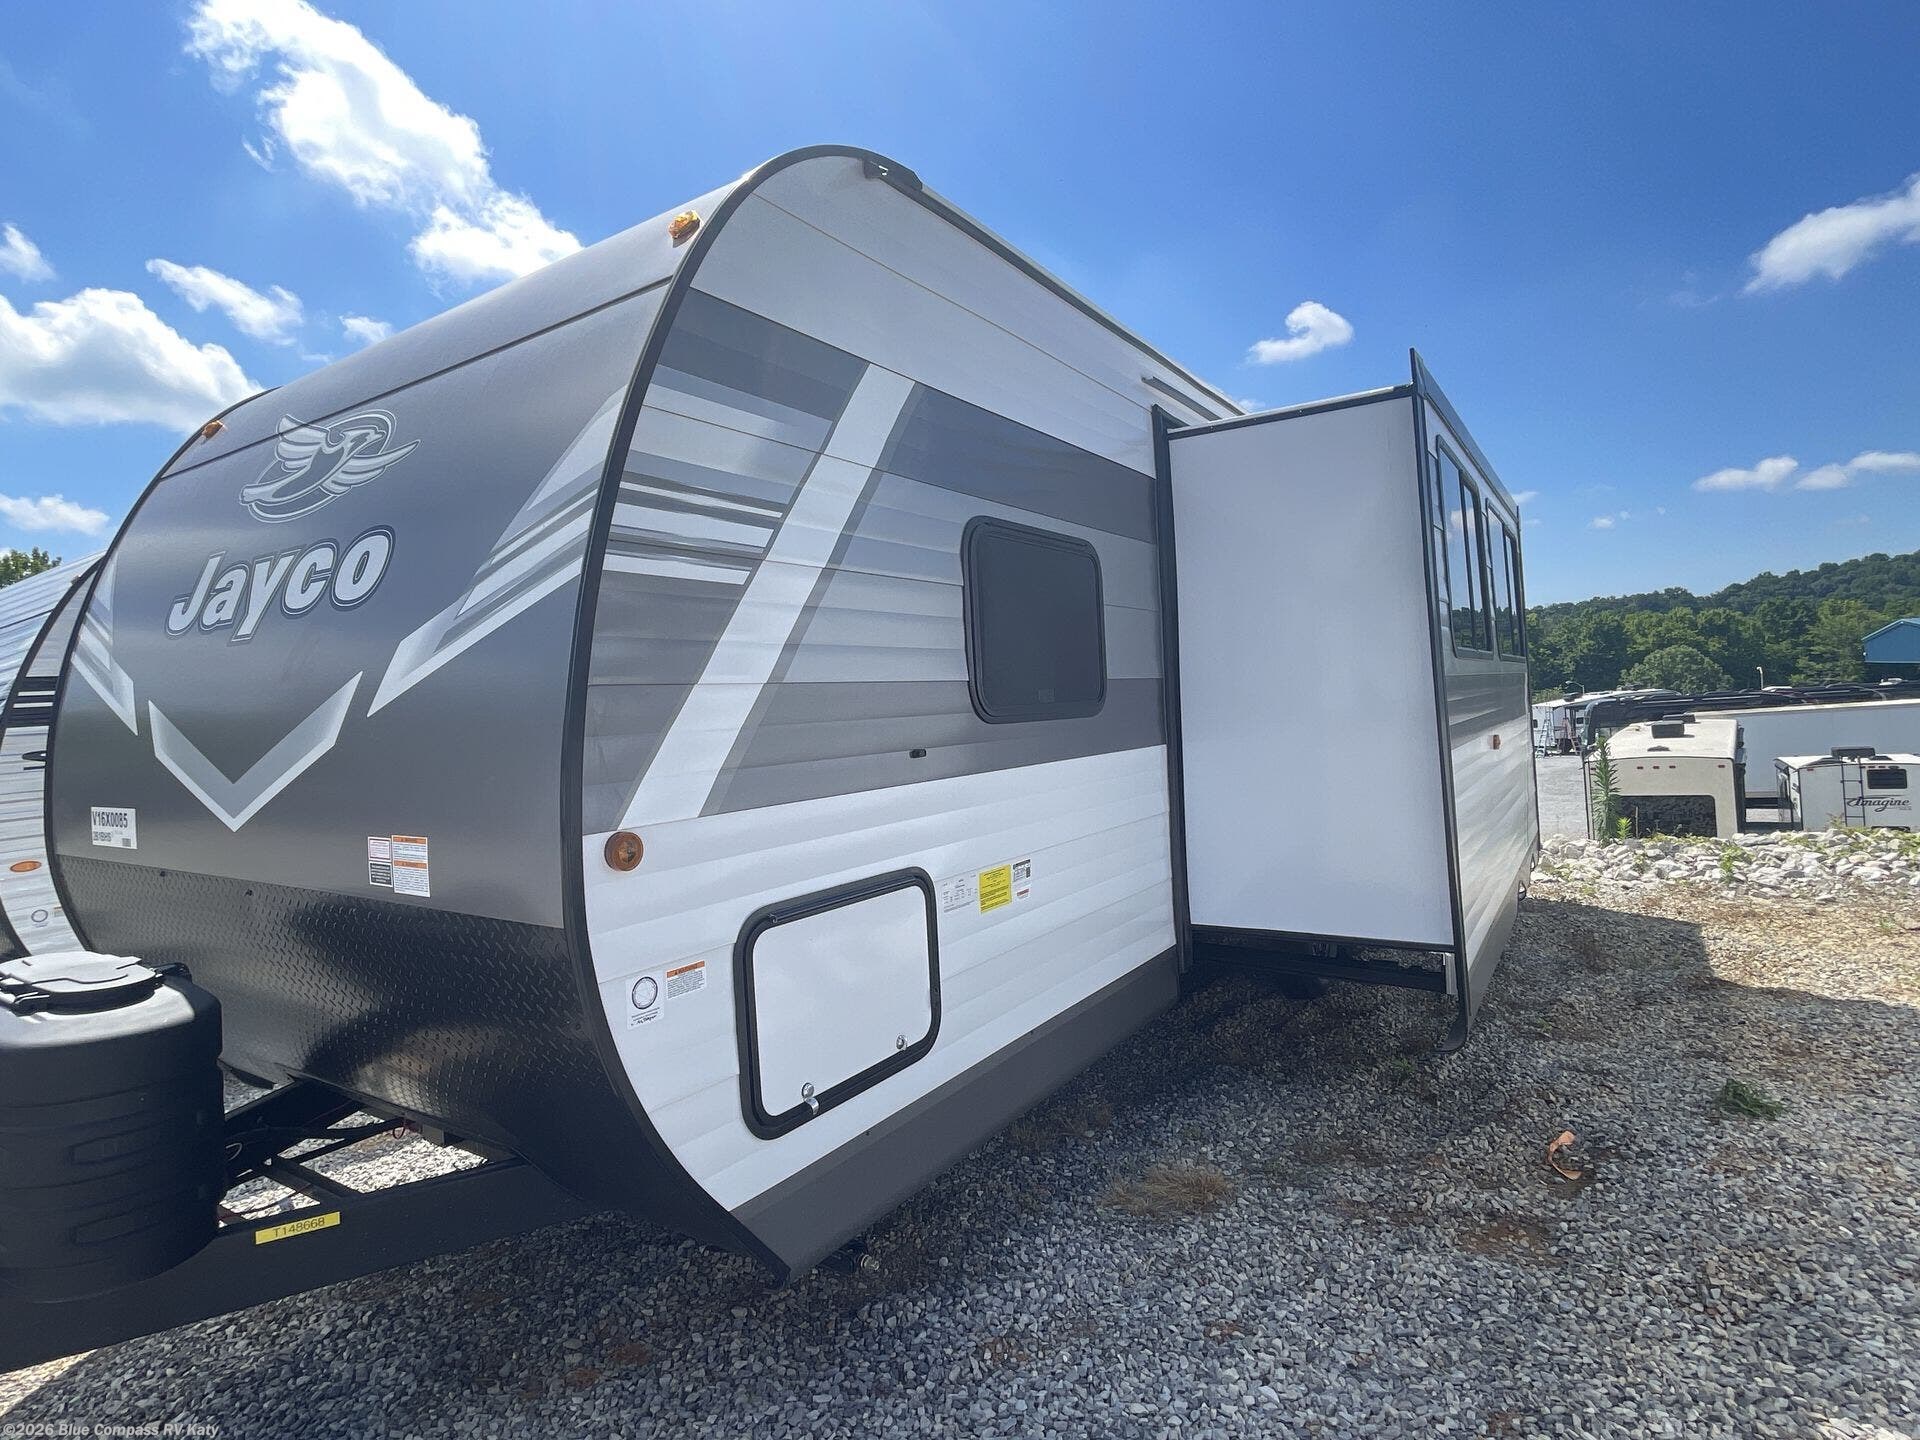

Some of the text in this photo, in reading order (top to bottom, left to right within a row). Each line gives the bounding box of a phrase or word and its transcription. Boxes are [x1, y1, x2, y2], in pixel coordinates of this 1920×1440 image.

[166, 528, 394, 642] Jayco
[1847, 796, 1910, 812] Imagine
[273, 1217, 325, 1237] T148668
